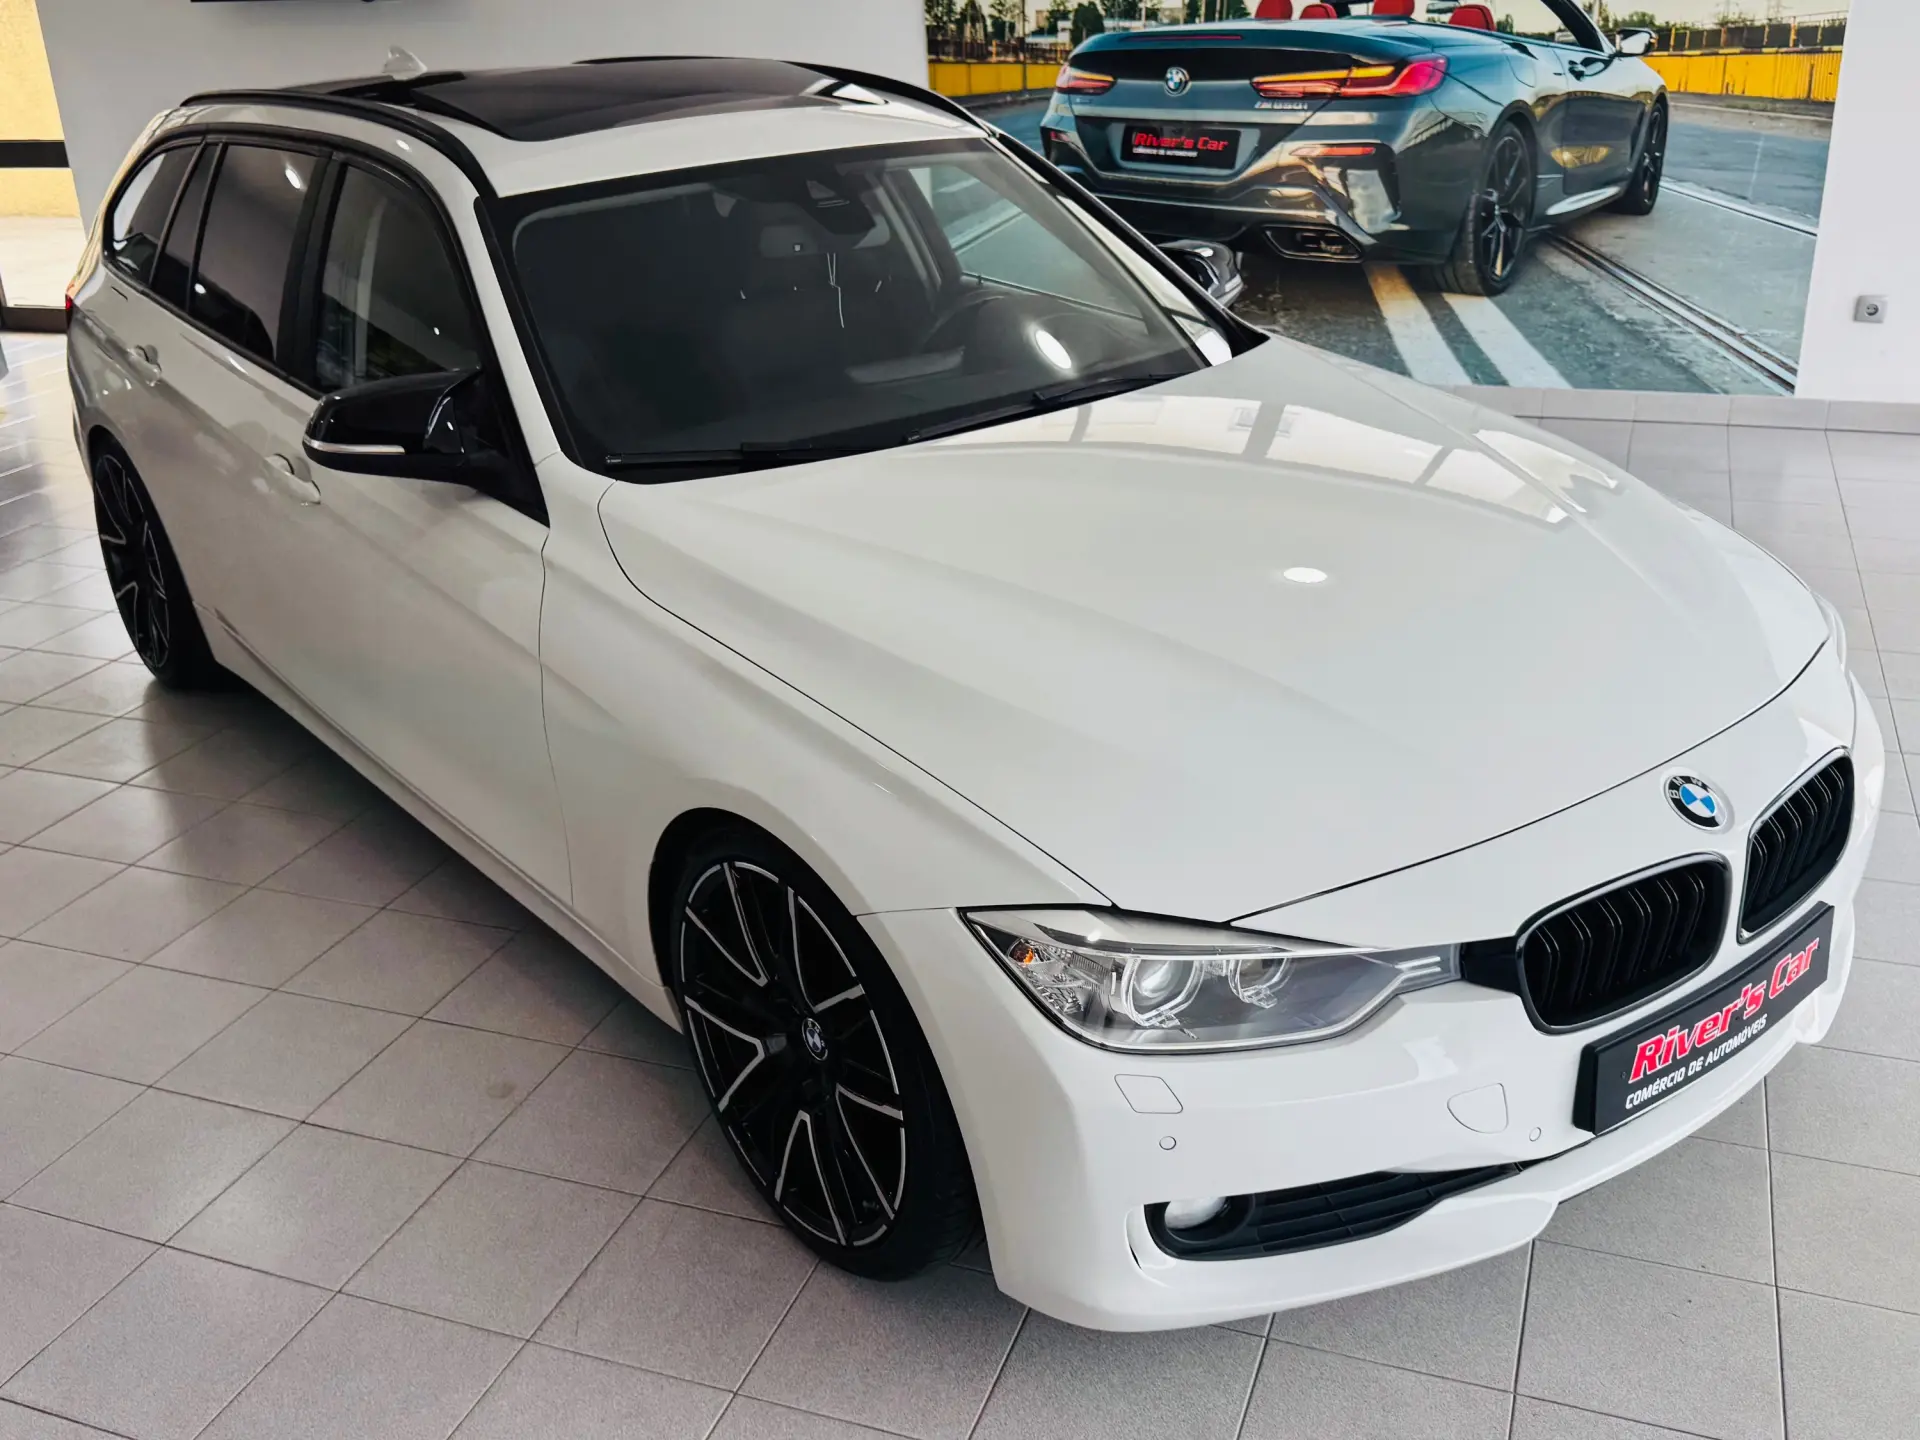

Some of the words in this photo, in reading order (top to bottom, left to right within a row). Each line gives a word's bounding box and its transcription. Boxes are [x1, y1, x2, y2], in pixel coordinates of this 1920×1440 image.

[1134, 132, 1195, 149] River's
[1197, 136, 1228, 151] Car
[1628, 982, 1767, 1084] River's
[1769, 937, 1820, 999] Car
[1625, 1066, 1686, 1110] COMÉRCIO
[1687, 1056, 1704, 1077] DE
[1705, 1013, 1768, 1067] AUTOMÓVEIS
